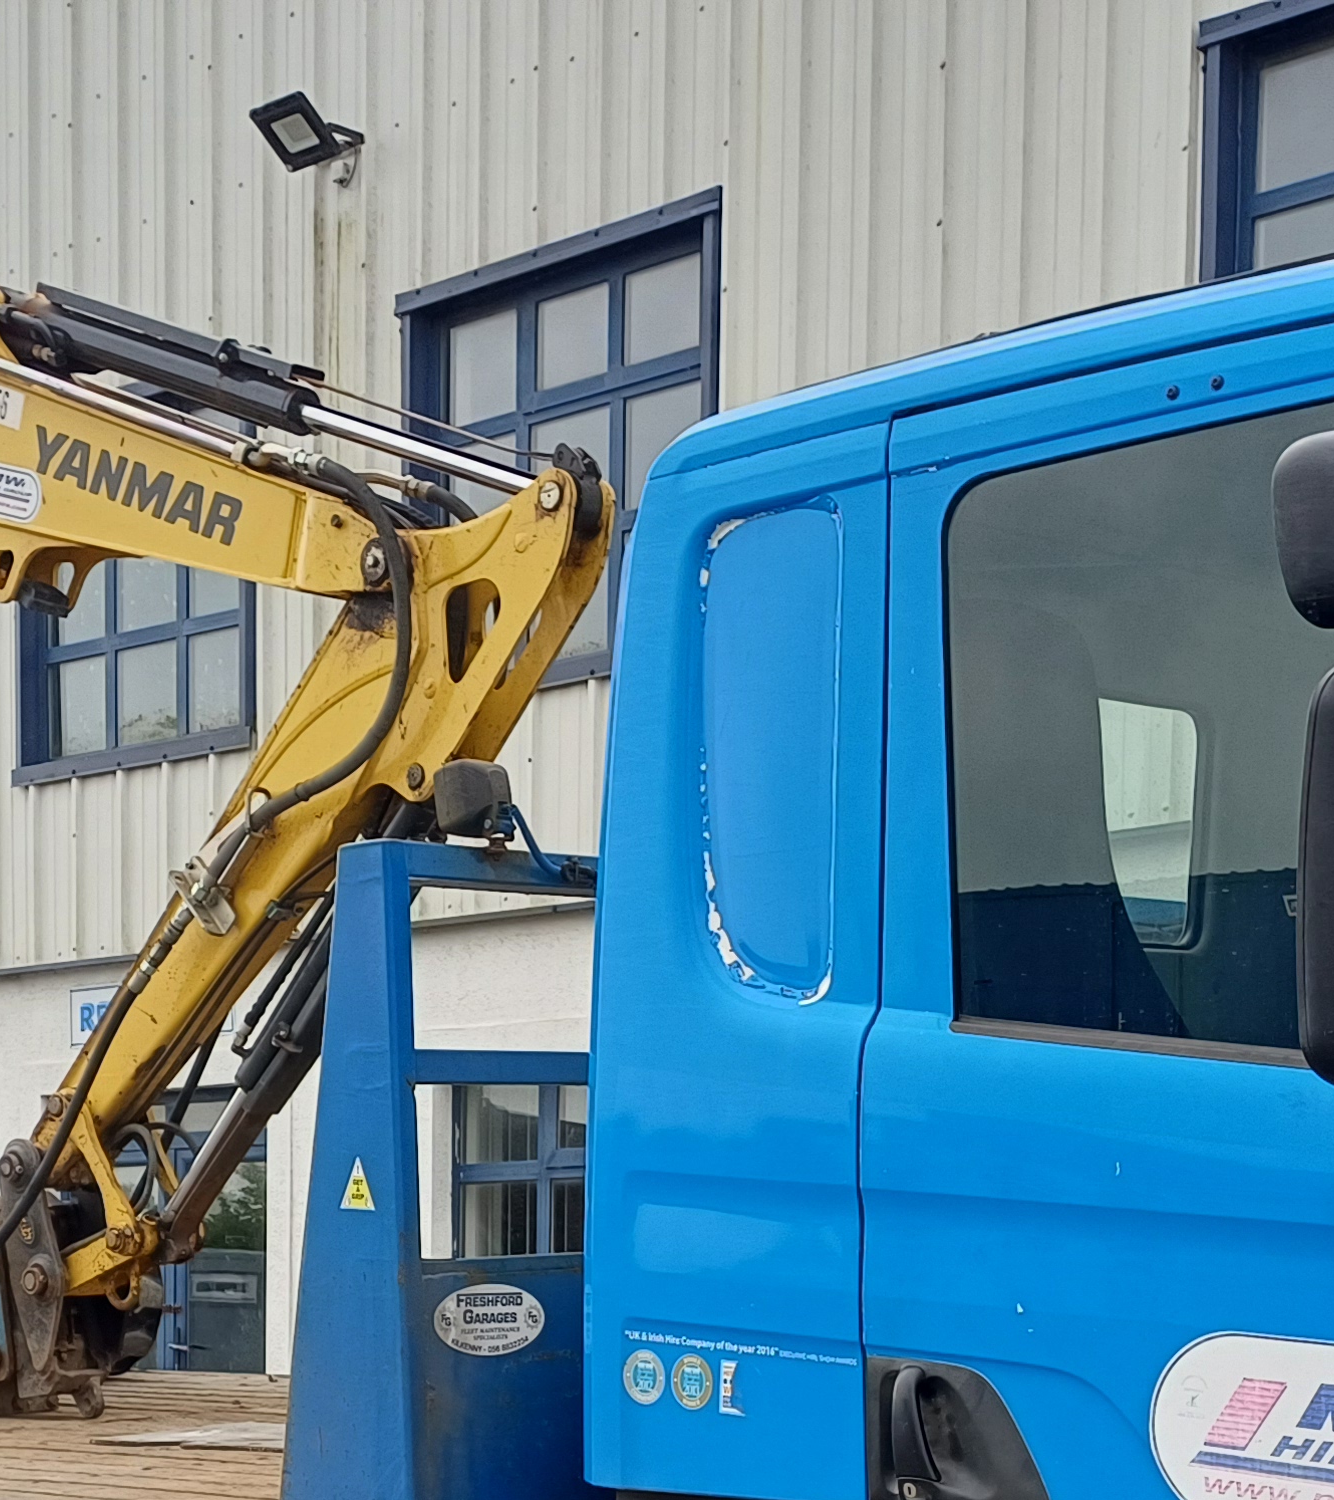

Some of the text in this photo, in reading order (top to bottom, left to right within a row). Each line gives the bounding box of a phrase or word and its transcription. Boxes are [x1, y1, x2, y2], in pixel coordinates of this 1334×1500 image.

[36, 424, 242, 546] YANMAR
[456, 1294, 523, 1308] FRESHFORD
[463, 1309, 518, 1325] GARAGES
[451, 1338, 482, 1352] KILKENNY
[648, 1332, 665, 1343] Irish
[665, 1334, 681, 1345] Hire
[681, 1335, 715, 1351] Company
[716, 1340, 725, 1350] of
[724, 1341, 738, 1352] the
[738, 1344, 755, 1355] year
